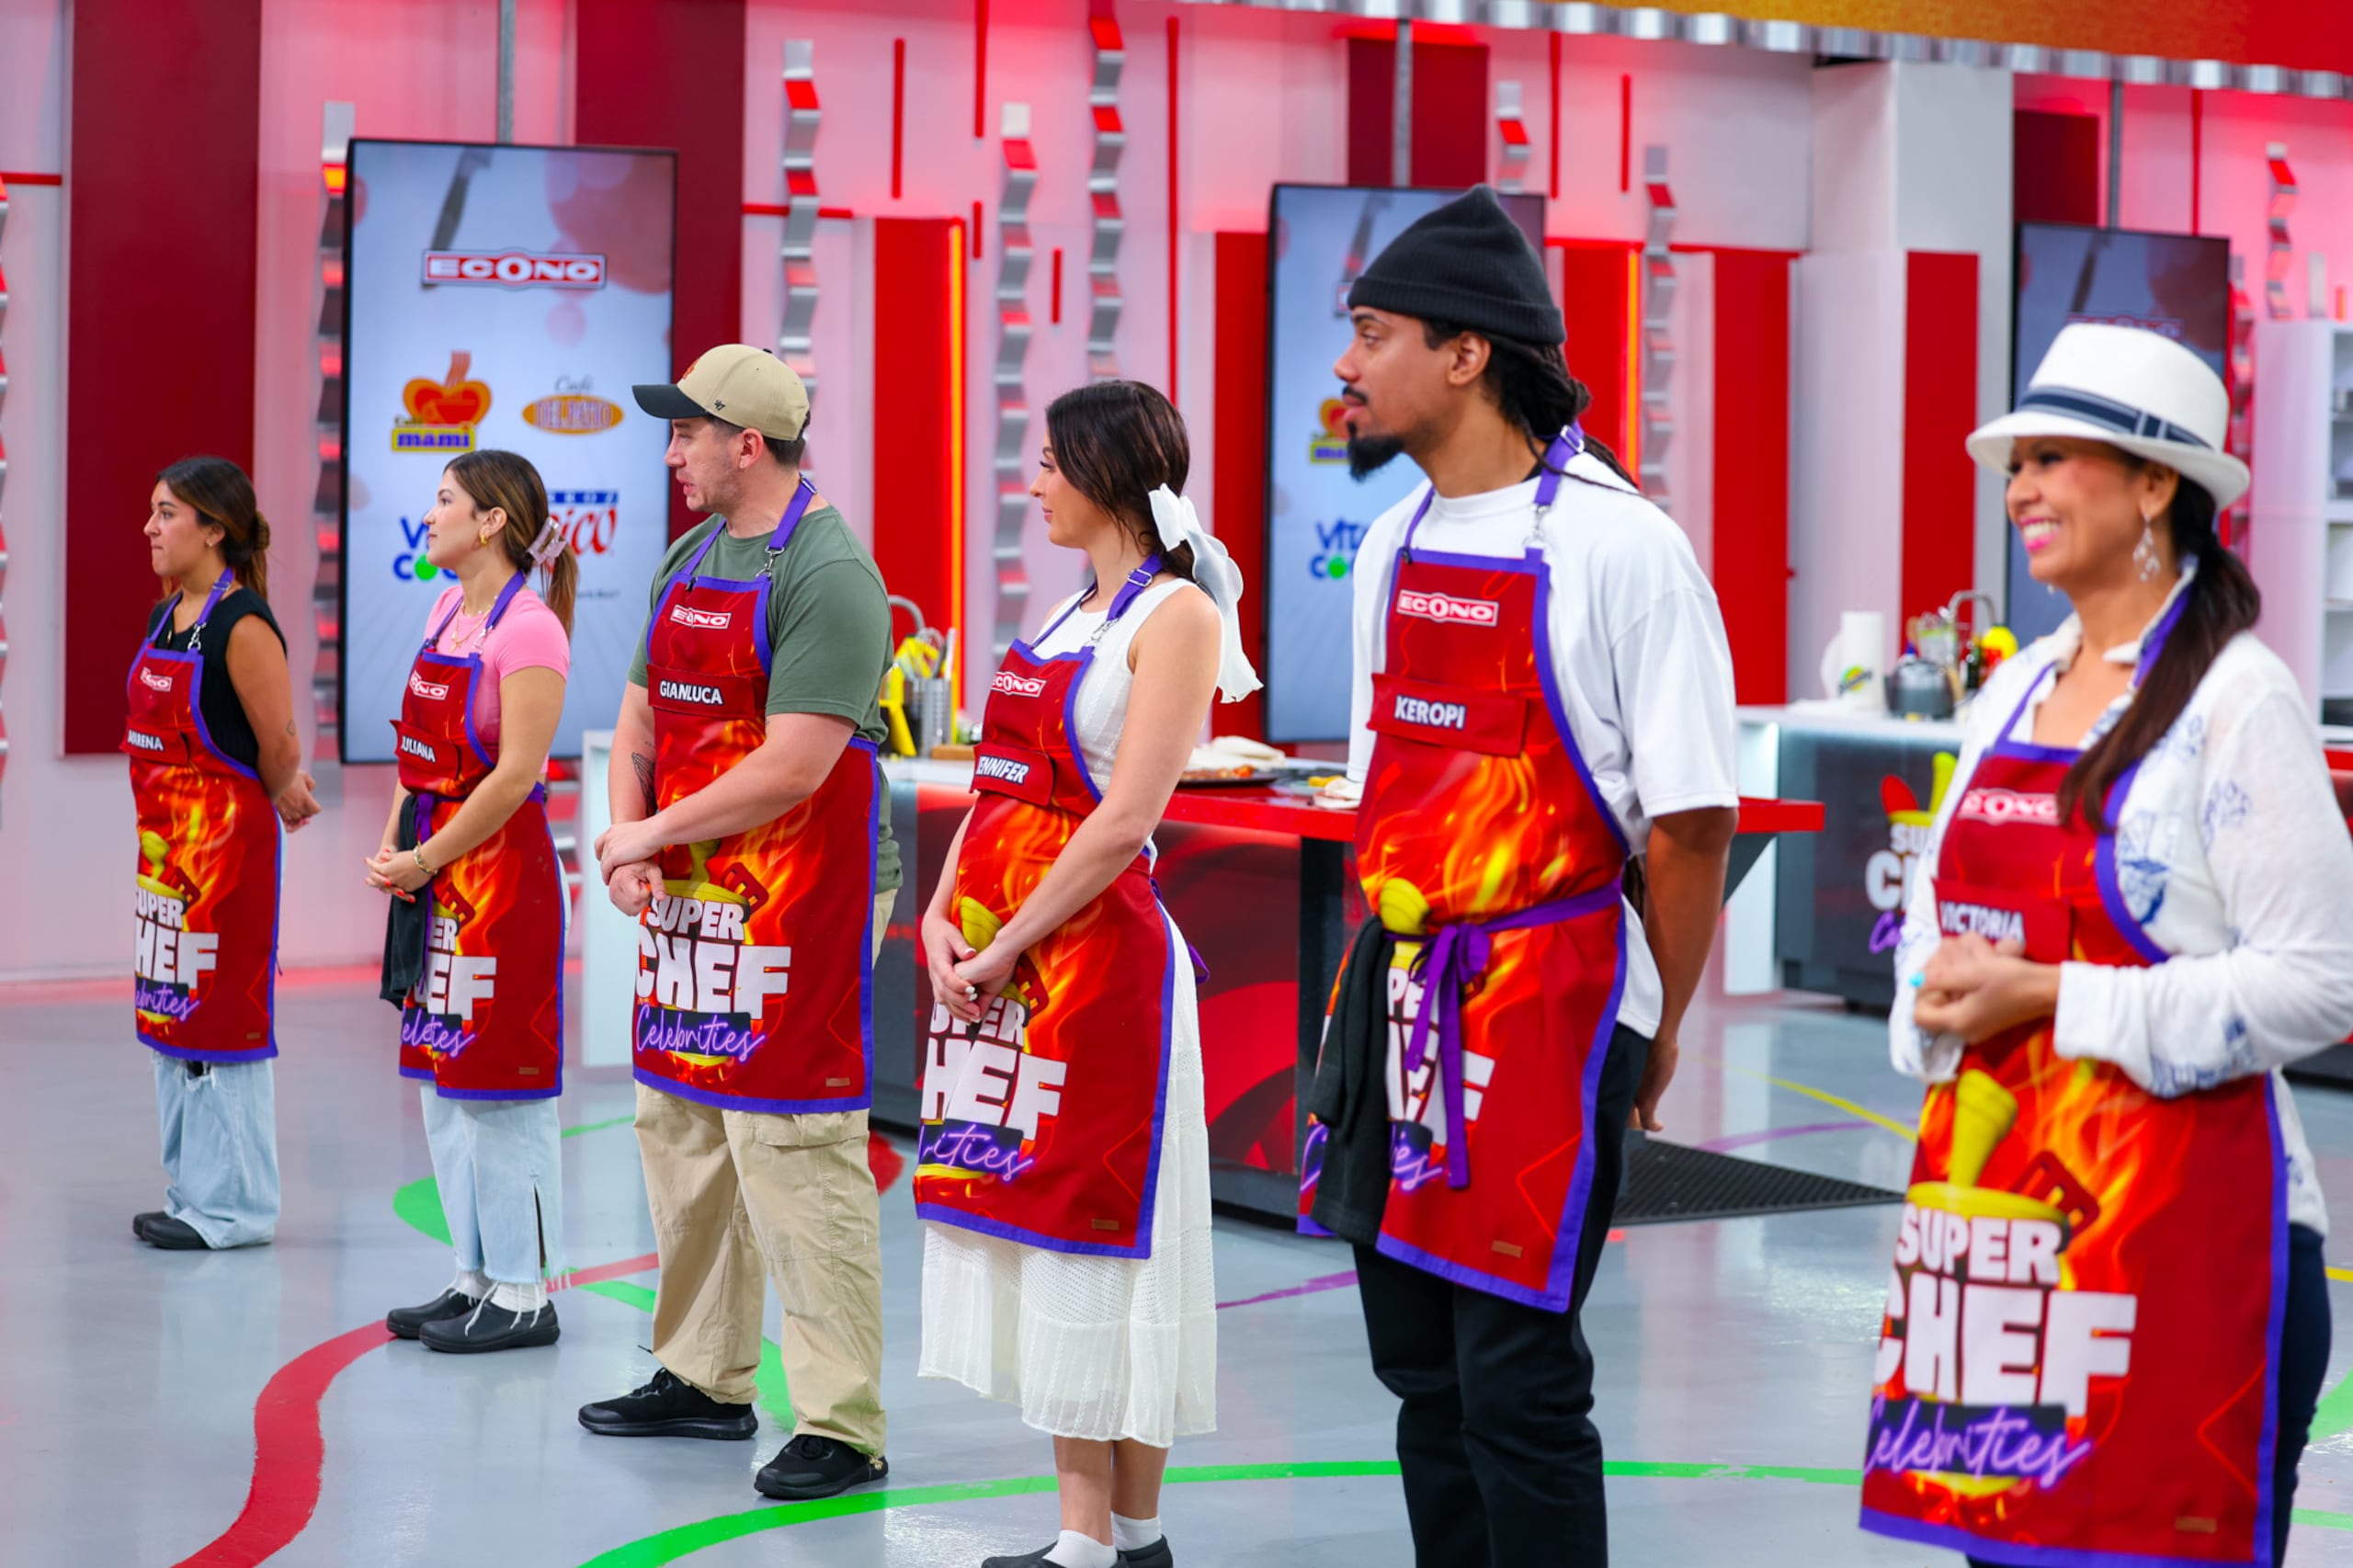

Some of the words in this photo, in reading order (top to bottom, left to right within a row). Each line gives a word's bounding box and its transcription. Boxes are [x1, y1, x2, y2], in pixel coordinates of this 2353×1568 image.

[428, 256, 598, 282] ECONO
[551, 506, 617, 555] ico
[1399, 597, 1494, 620] ECONO
[660, 680, 723, 705] GIANLUCA
[1394, 695, 1466, 729] KEROPI
[136, 887, 184, 929] UPER
[646, 895, 745, 940] SUPER
[135, 915, 219, 990] HEF
[636, 924, 791, 1020] CHEF
[636, 1004, 766, 1062] Celebrities
[921, 1036, 1067, 1142] HEF
[1895, 1200, 2062, 1285] SUPER
[1873, 1265, 2138, 1417] CHEF
